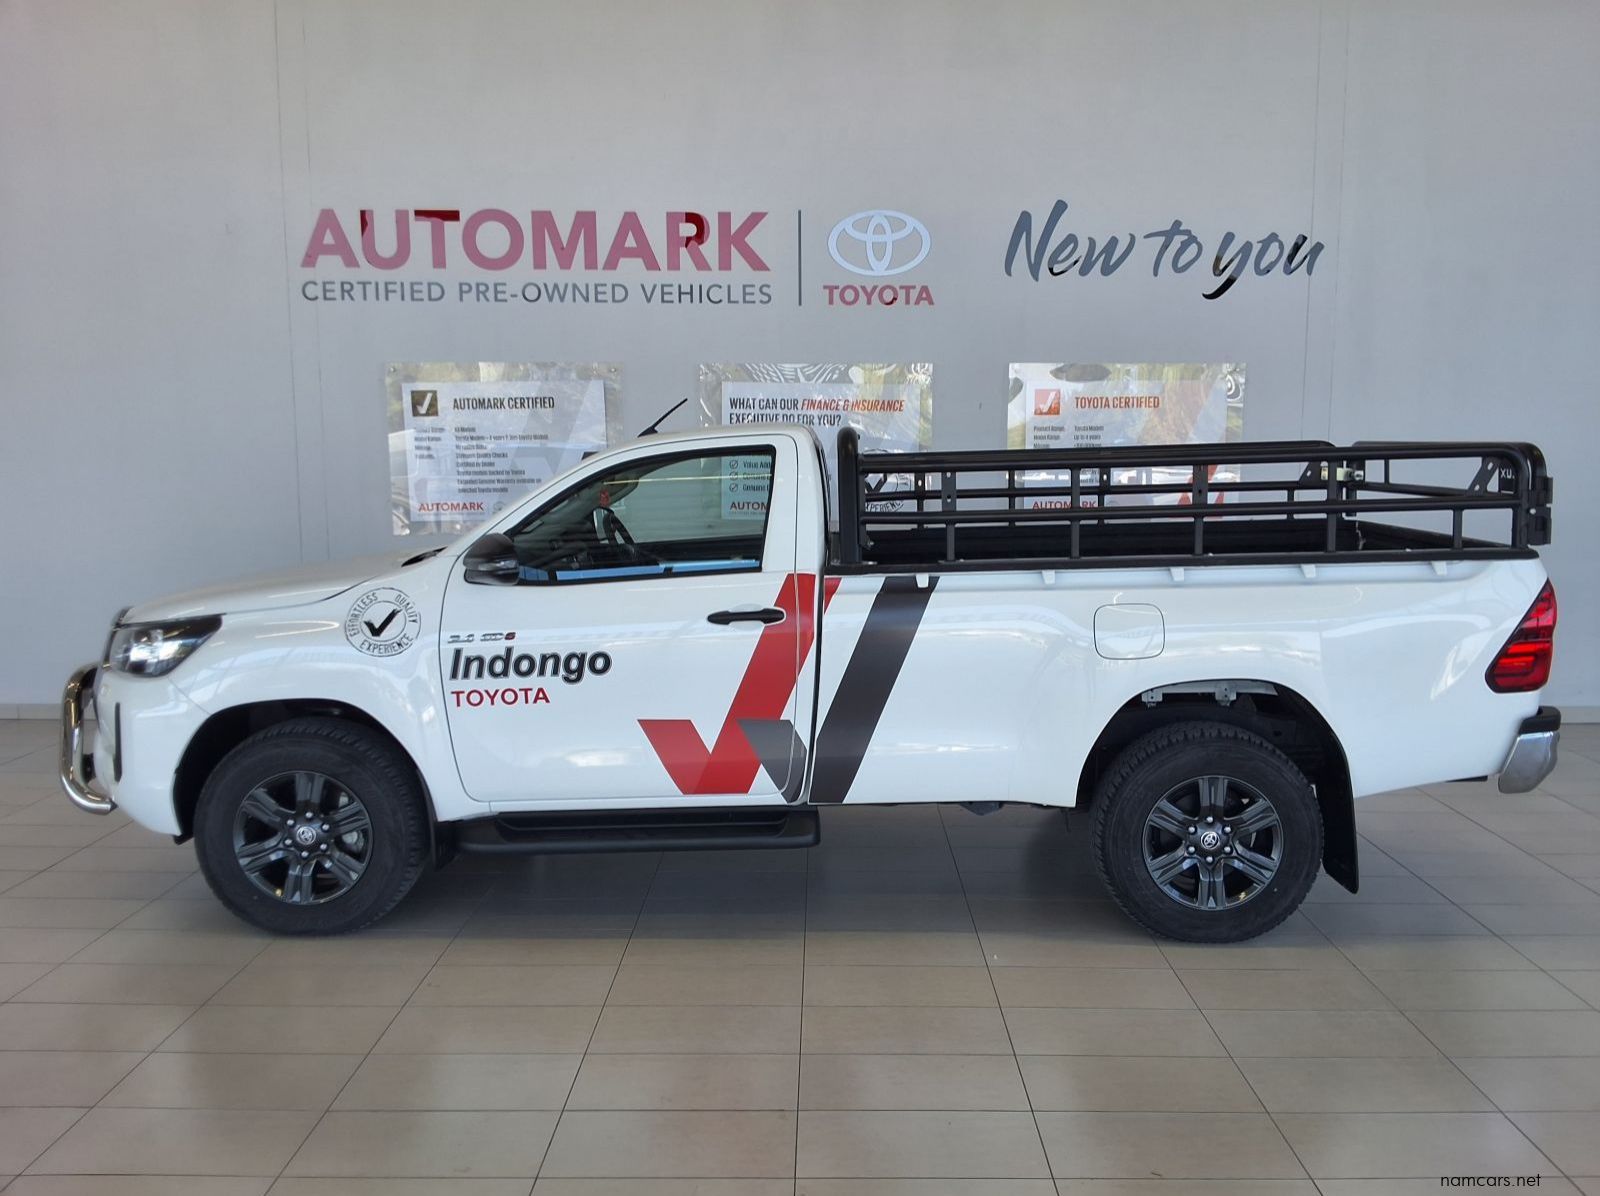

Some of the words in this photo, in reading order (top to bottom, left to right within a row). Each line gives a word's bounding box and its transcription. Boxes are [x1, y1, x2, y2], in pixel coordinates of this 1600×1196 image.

[300, 208, 771, 272] AUTOMARK
[1003, 200, 1136, 281] New
[1143, 220, 1204, 278] to
[1202, 231, 1326, 300] you
[301, 280, 446, 303] CERTIFIED
[457, 281, 629, 304] PRE-OWNED
[640, 282, 773, 305] VEHICLES
[823, 284, 935, 306] TOYOTA
[452, 397, 506, 410] AUTOMARK
[507, 396, 555, 410] CERTIFIED
[729, 397, 757, 410] WHAT
[758, 398, 779, 411] CAN
[779, 398, 799, 411] OUR
[800, 398, 841, 411] FINANCE
[850, 399, 905, 412] INSURANCE
[1074, 396, 1110, 409] TOYOTA
[1112, 395, 1160, 409] CERTIFIED
[729, 413, 781, 424] EXECUTIVE
[781, 413, 797, 423] DO
[797, 414, 815, 425] FOR
[817, 414, 842, 426] YOU?
[418, 502, 484, 513] AUTOMARK
[1032, 501, 1098, 510] AUTOMRK
[348, 592, 378, 637] EFFORTLESS
[394, 594, 418, 623] QUALITY
[360, 633, 414, 654] EXPERIENCE
[450, 646, 612, 685] Indongo
[451, 688, 550, 707] TOYOTA
